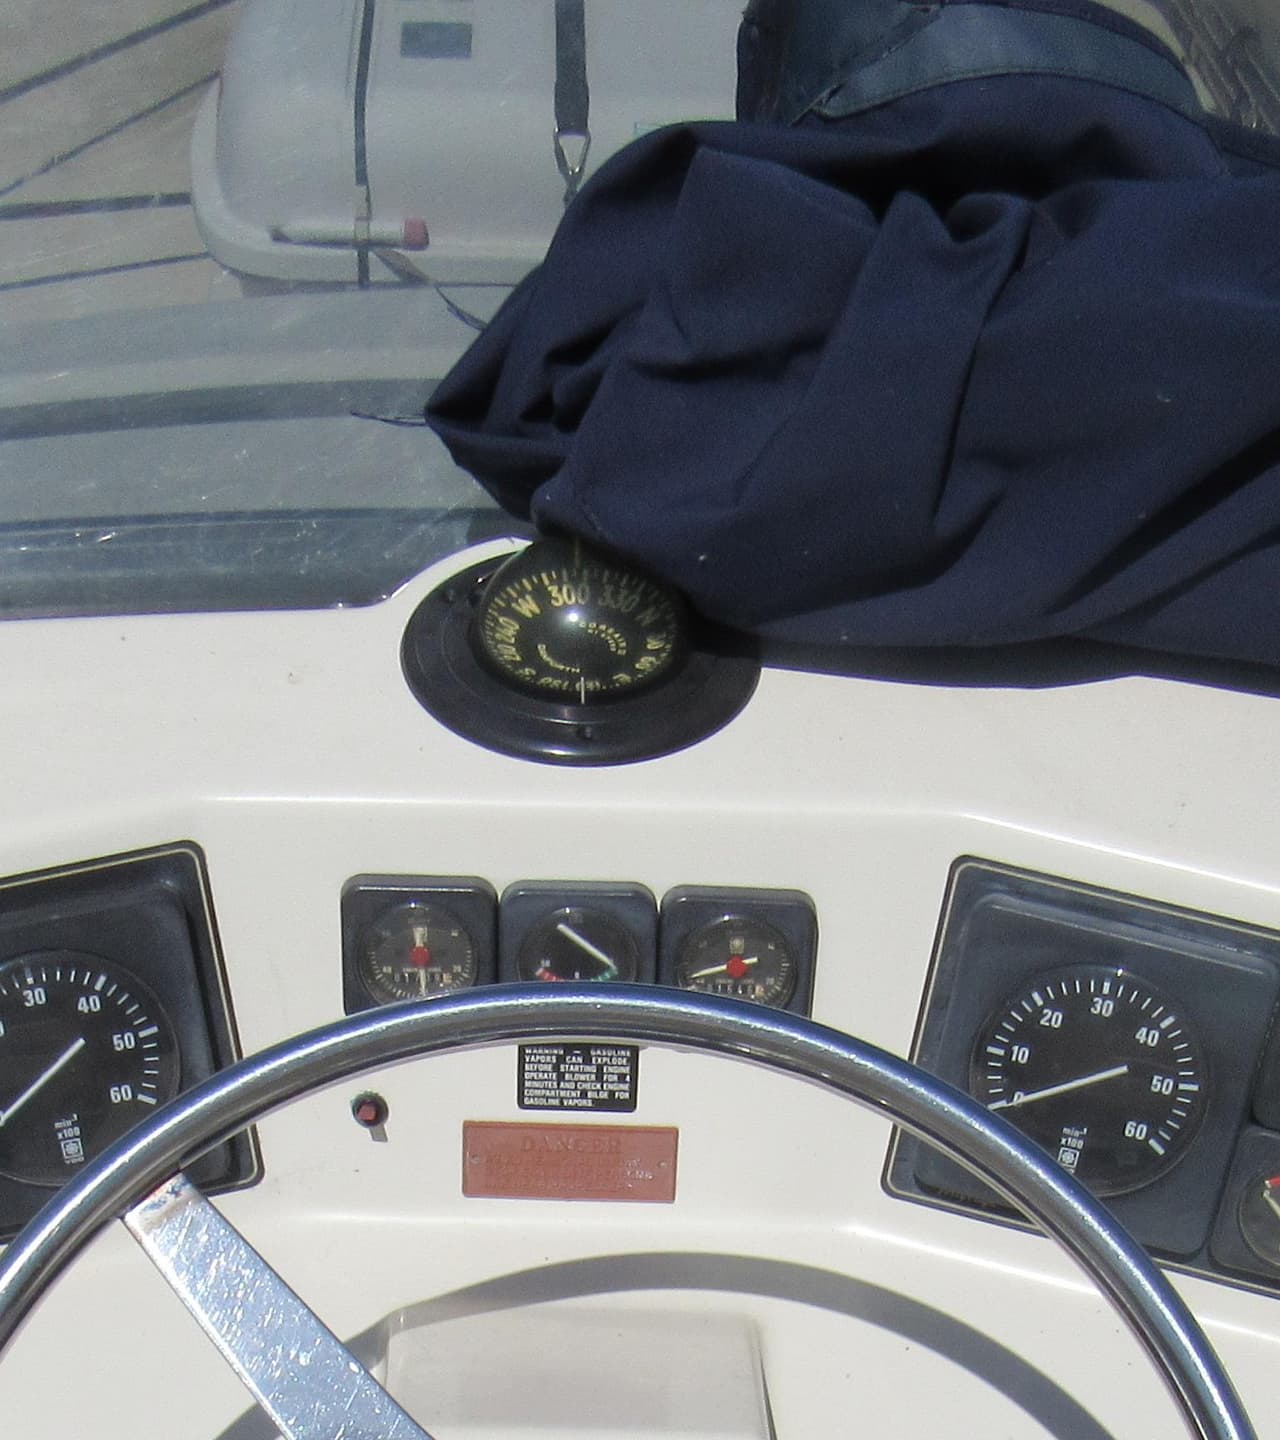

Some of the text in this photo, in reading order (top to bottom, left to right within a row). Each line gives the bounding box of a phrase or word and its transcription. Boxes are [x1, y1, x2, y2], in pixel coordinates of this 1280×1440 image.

[548, 583, 590, 607] 300
[598, 583, 640, 613] 330
[512, 595, 541, 618] W
[22, 987, 46, 1007] 30
[77, 995, 101, 1014] 40
[1090, 997, 1114, 1017] 30
[1039, 1009, 1063, 1029] 20
[113, 1032, 136, 1051] 50
[1135, 1027, 1159, 1047] 40
[525, 1055, 557, 1063] VAPORS
[1010, 1045, 1030, 1064] 10
[525, 1063, 631, 1074] BEFORE STARTING ENGINE
[525, 1072, 557, 1080] OPERATE
[565, 1073, 596, 1081] BLOWER
[110, 1084, 133, 1104] 60
[524, 1089, 630, 1099] COMPARTMENT BILGE FOR
[525, 1081, 630, 1091] MINUTES AND CHECK ENGINE
[1150, 1075, 1174, 1096] 50
[524, 1097, 561, 1106] GASOLINE
[1124, 1121, 1147, 1141] 60
[521, 1136, 621, 1153] DANGER
[1061, 1138, 1084, 1149] x100
